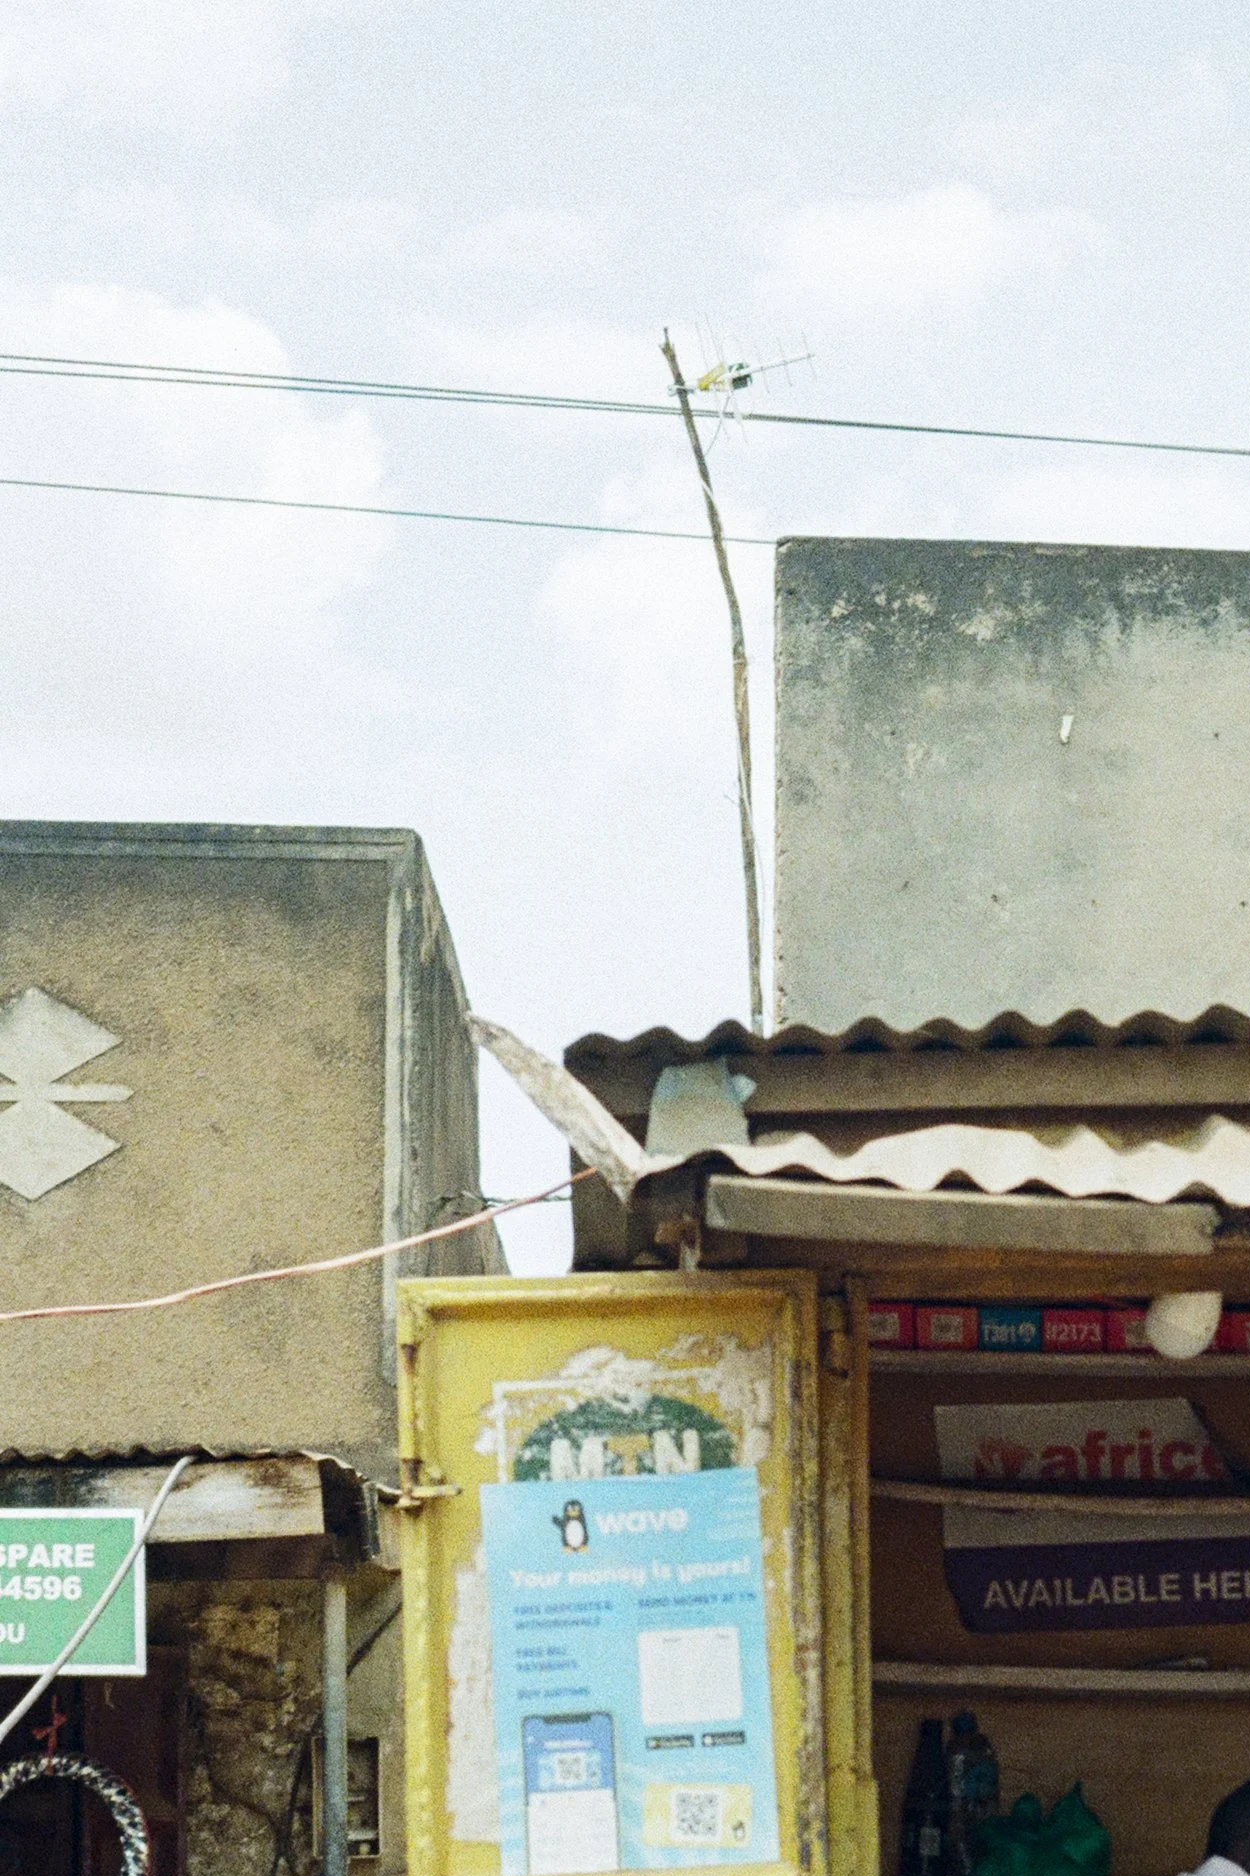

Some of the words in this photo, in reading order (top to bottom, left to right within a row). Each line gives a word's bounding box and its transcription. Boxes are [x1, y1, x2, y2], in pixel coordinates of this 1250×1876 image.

[550, 1428, 700, 1482] MTN
[596, 1507, 689, 1535] wave
[509, 1570, 562, 1588] Your
[567, 1567, 646, 1586] money
[983, 1573, 1182, 1611] AVAILABLE
